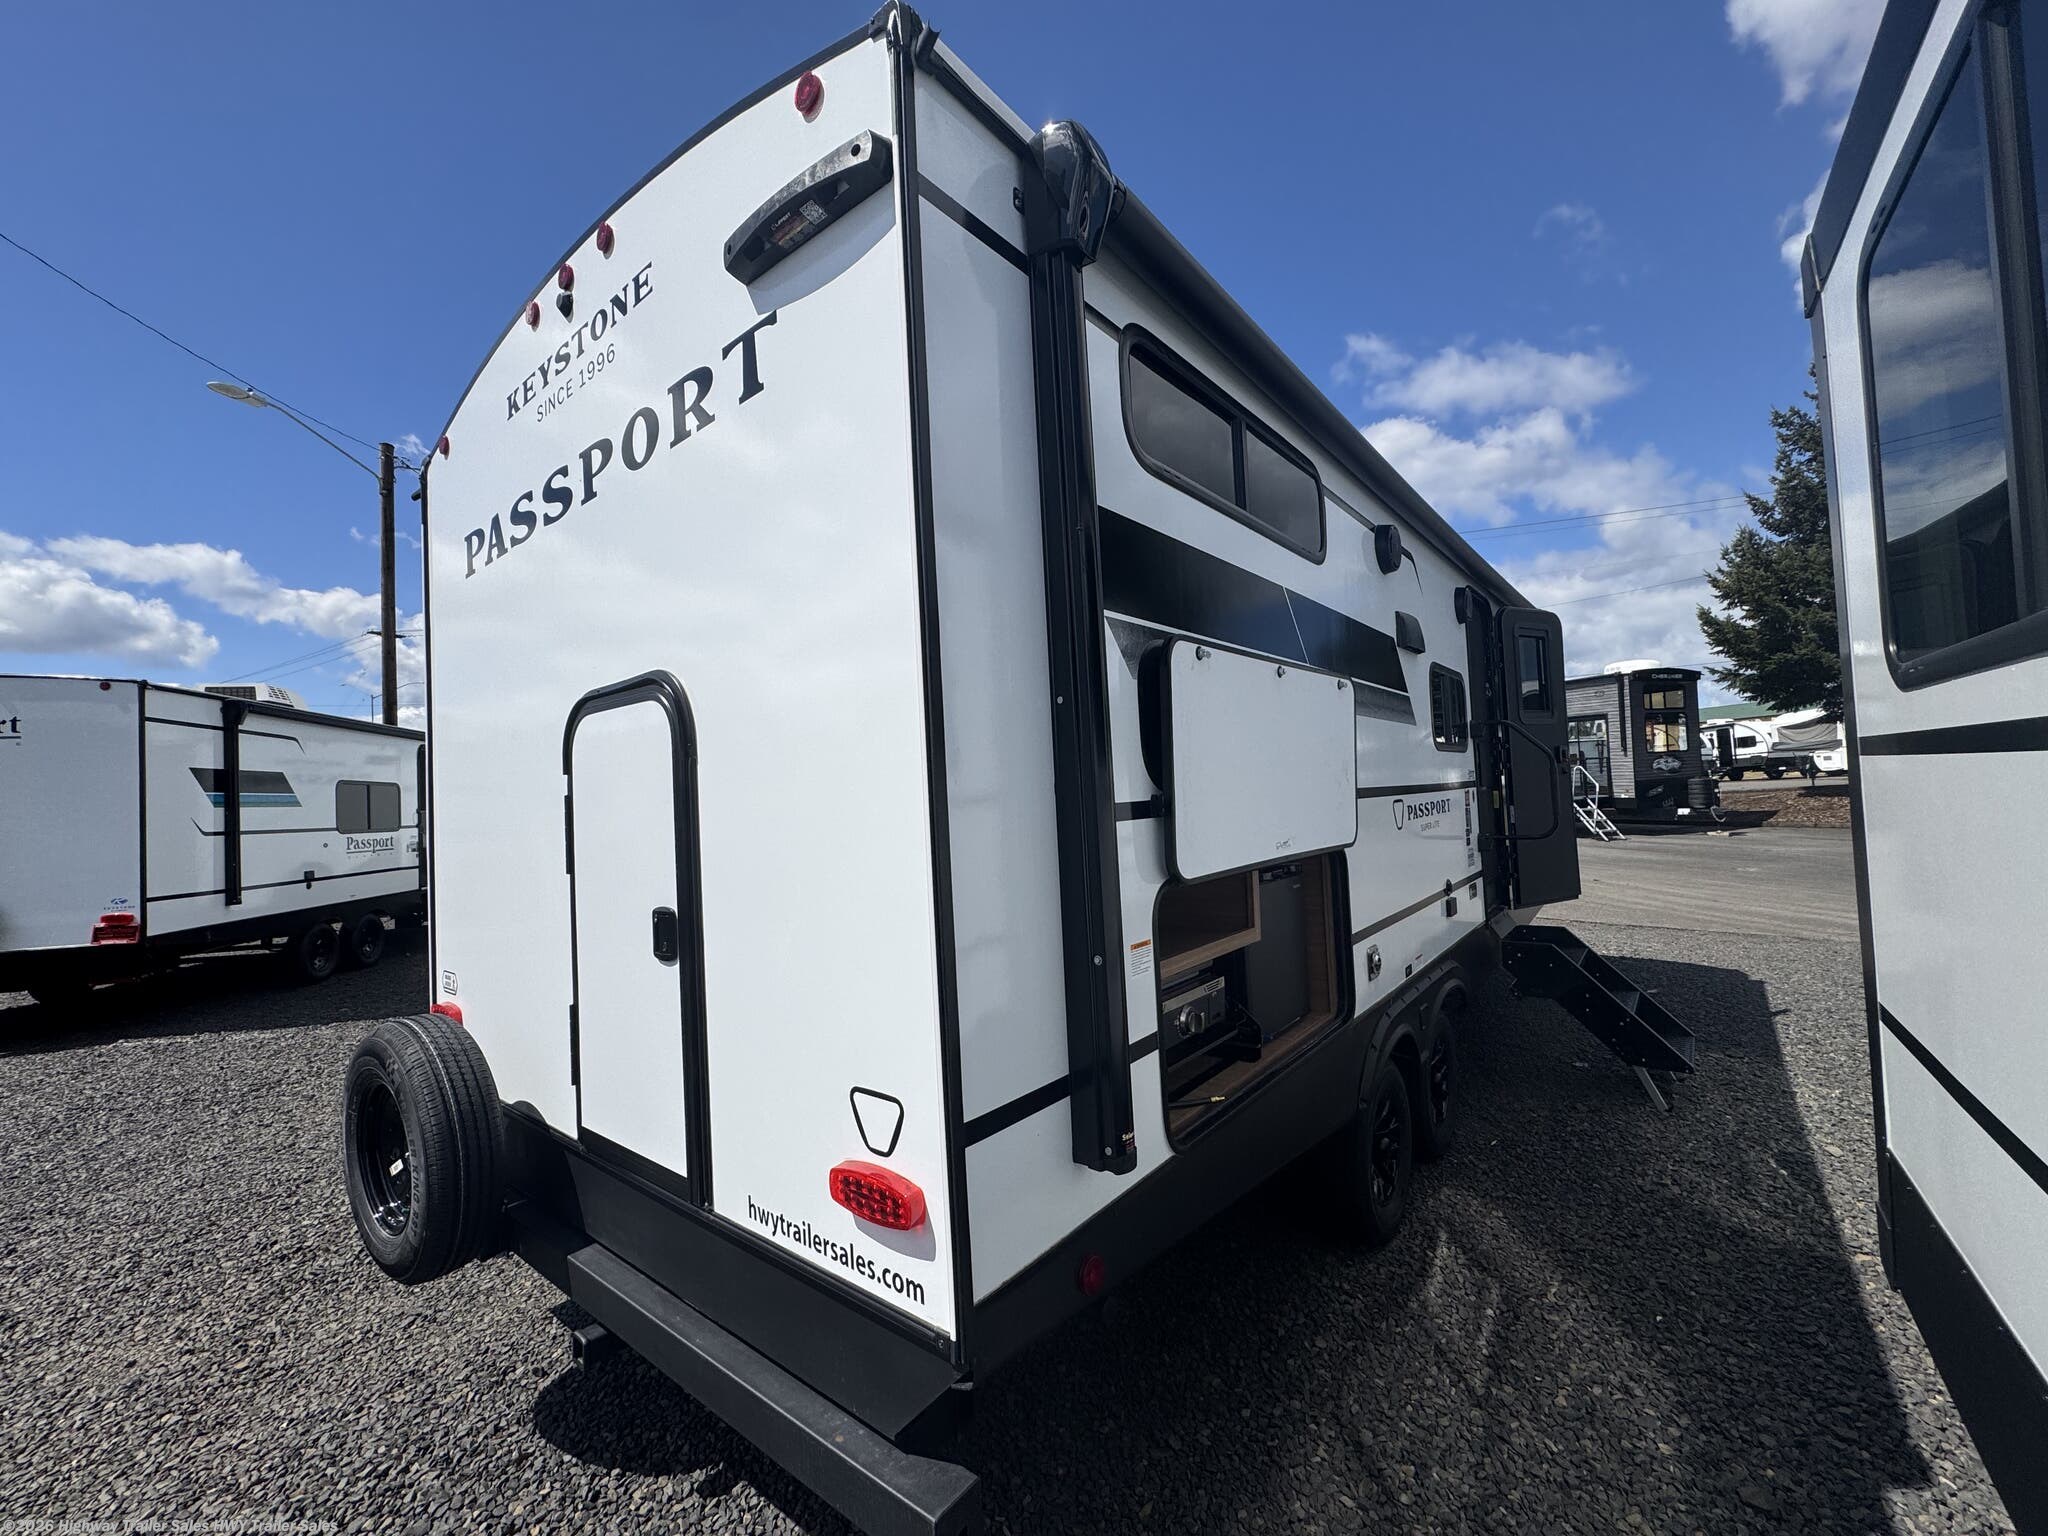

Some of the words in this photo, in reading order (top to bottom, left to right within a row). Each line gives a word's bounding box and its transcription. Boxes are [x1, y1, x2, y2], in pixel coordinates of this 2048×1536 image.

[507, 261, 653, 421] KEYSTONE
[537, 379, 573, 422] SINCE
[579, 343, 615, 389] 1996
[463, 310, 778, 579] PASSPORT
[346, 836, 394, 854] Passport
[1407, 798, 1451, 821] PASSPORT
[747, 1194, 926, 1306] hwytrailersales.com
